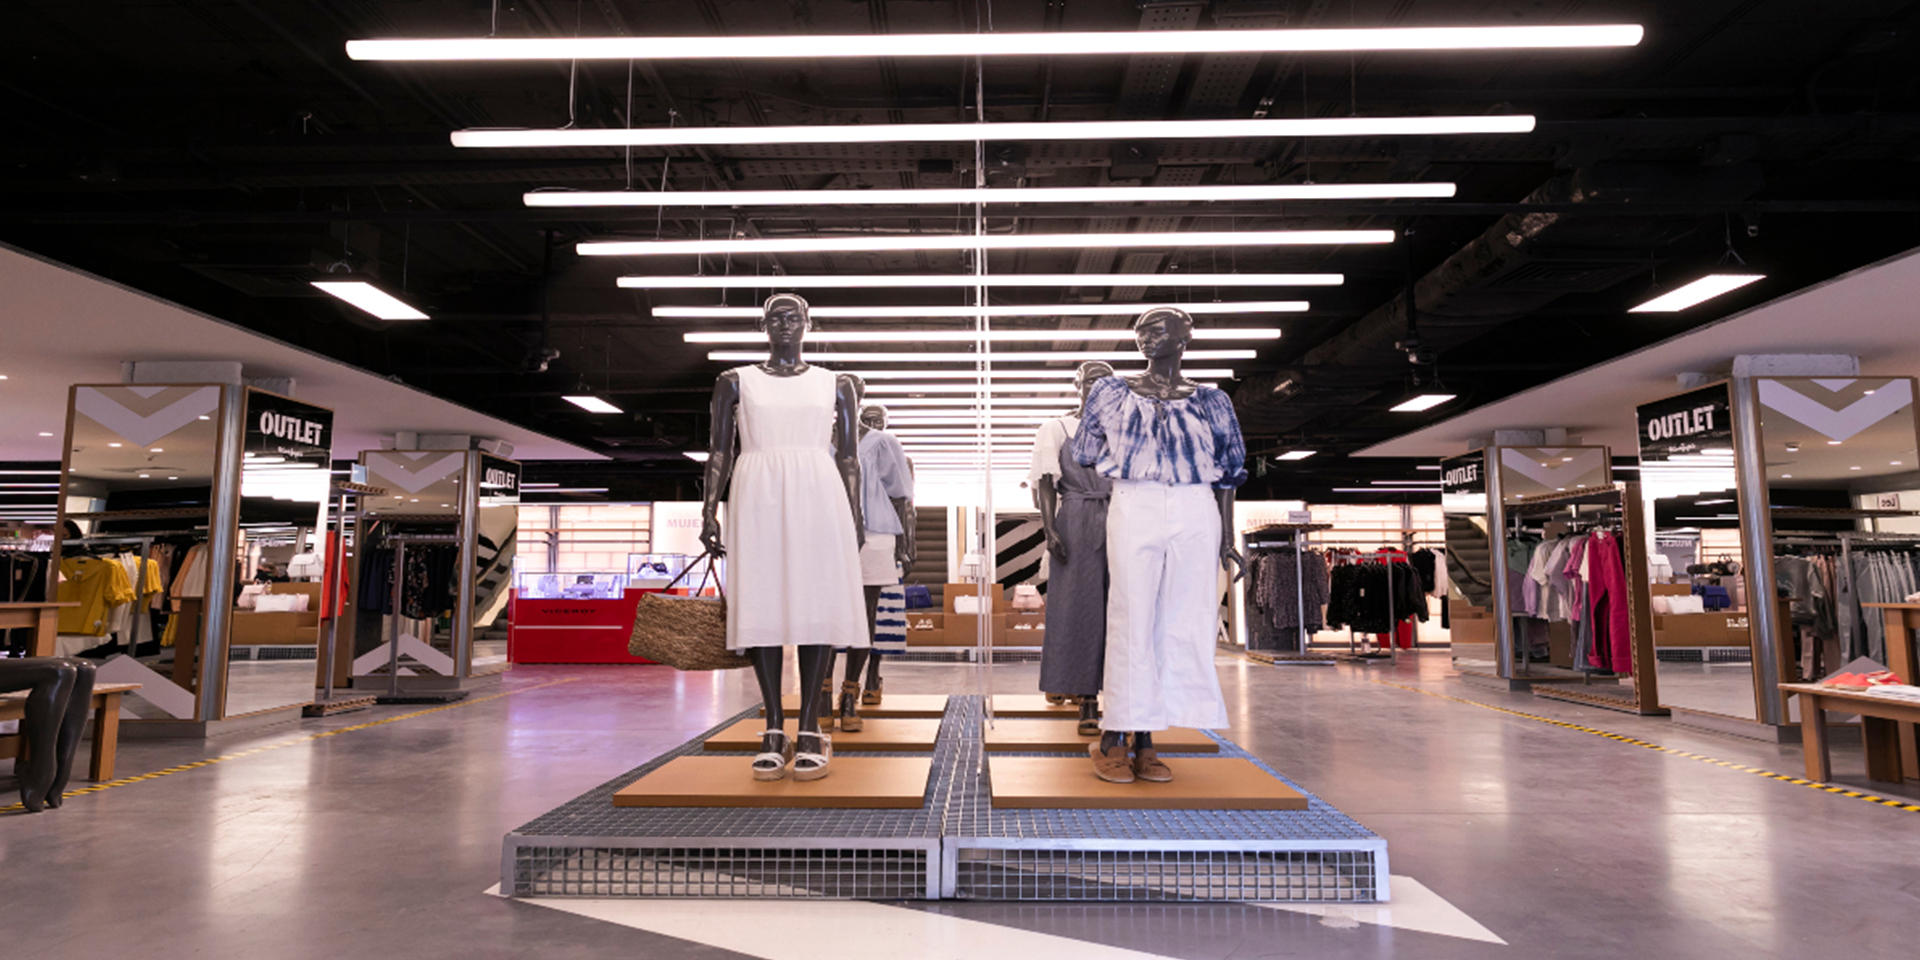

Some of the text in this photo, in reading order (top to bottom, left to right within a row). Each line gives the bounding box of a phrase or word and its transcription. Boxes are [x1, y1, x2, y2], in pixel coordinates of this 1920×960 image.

[260, 411, 323, 446] OUTLET
[1648, 405, 1715, 441] OUTLET
[486, 467, 516, 489] OUTLET
[1446, 464, 1478, 487] OUTLET
[667, 519, 704, 528] MUJE
